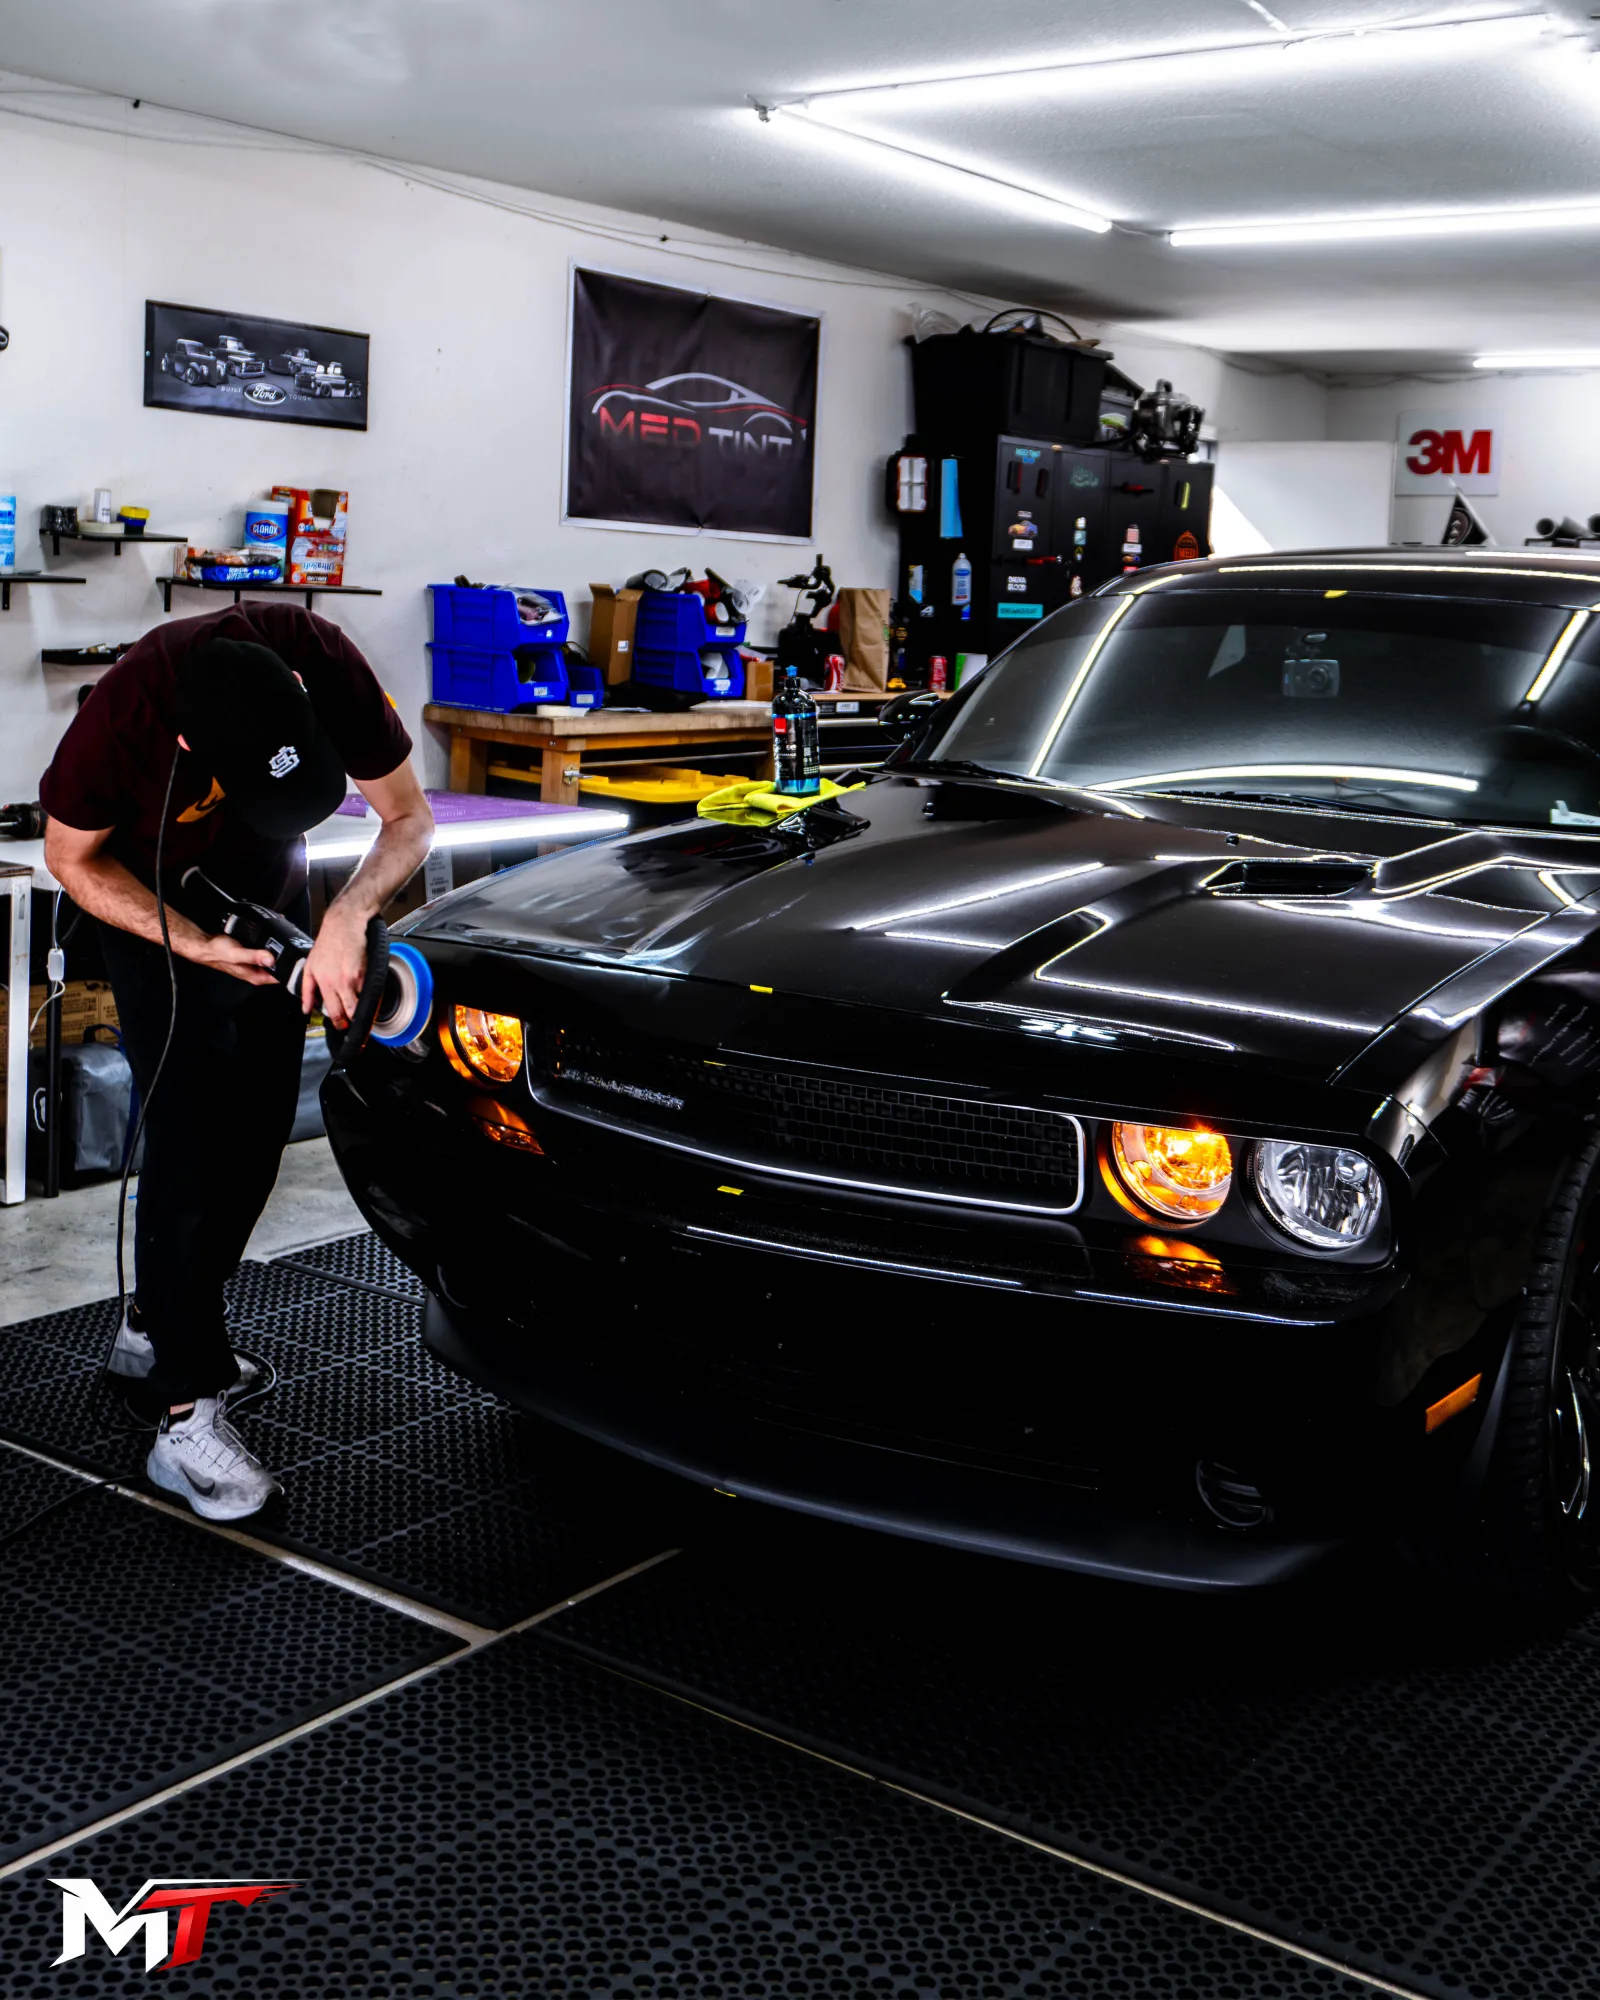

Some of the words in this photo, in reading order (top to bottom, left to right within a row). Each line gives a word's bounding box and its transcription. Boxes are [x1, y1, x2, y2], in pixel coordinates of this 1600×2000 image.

[252, 384, 277, 400] Ford
[600, 406, 701, 446] MED
[708, 427, 793, 458] TINT
[1405, 429, 1492, 475] 3M
[252, 524, 278, 535] CLOROX
